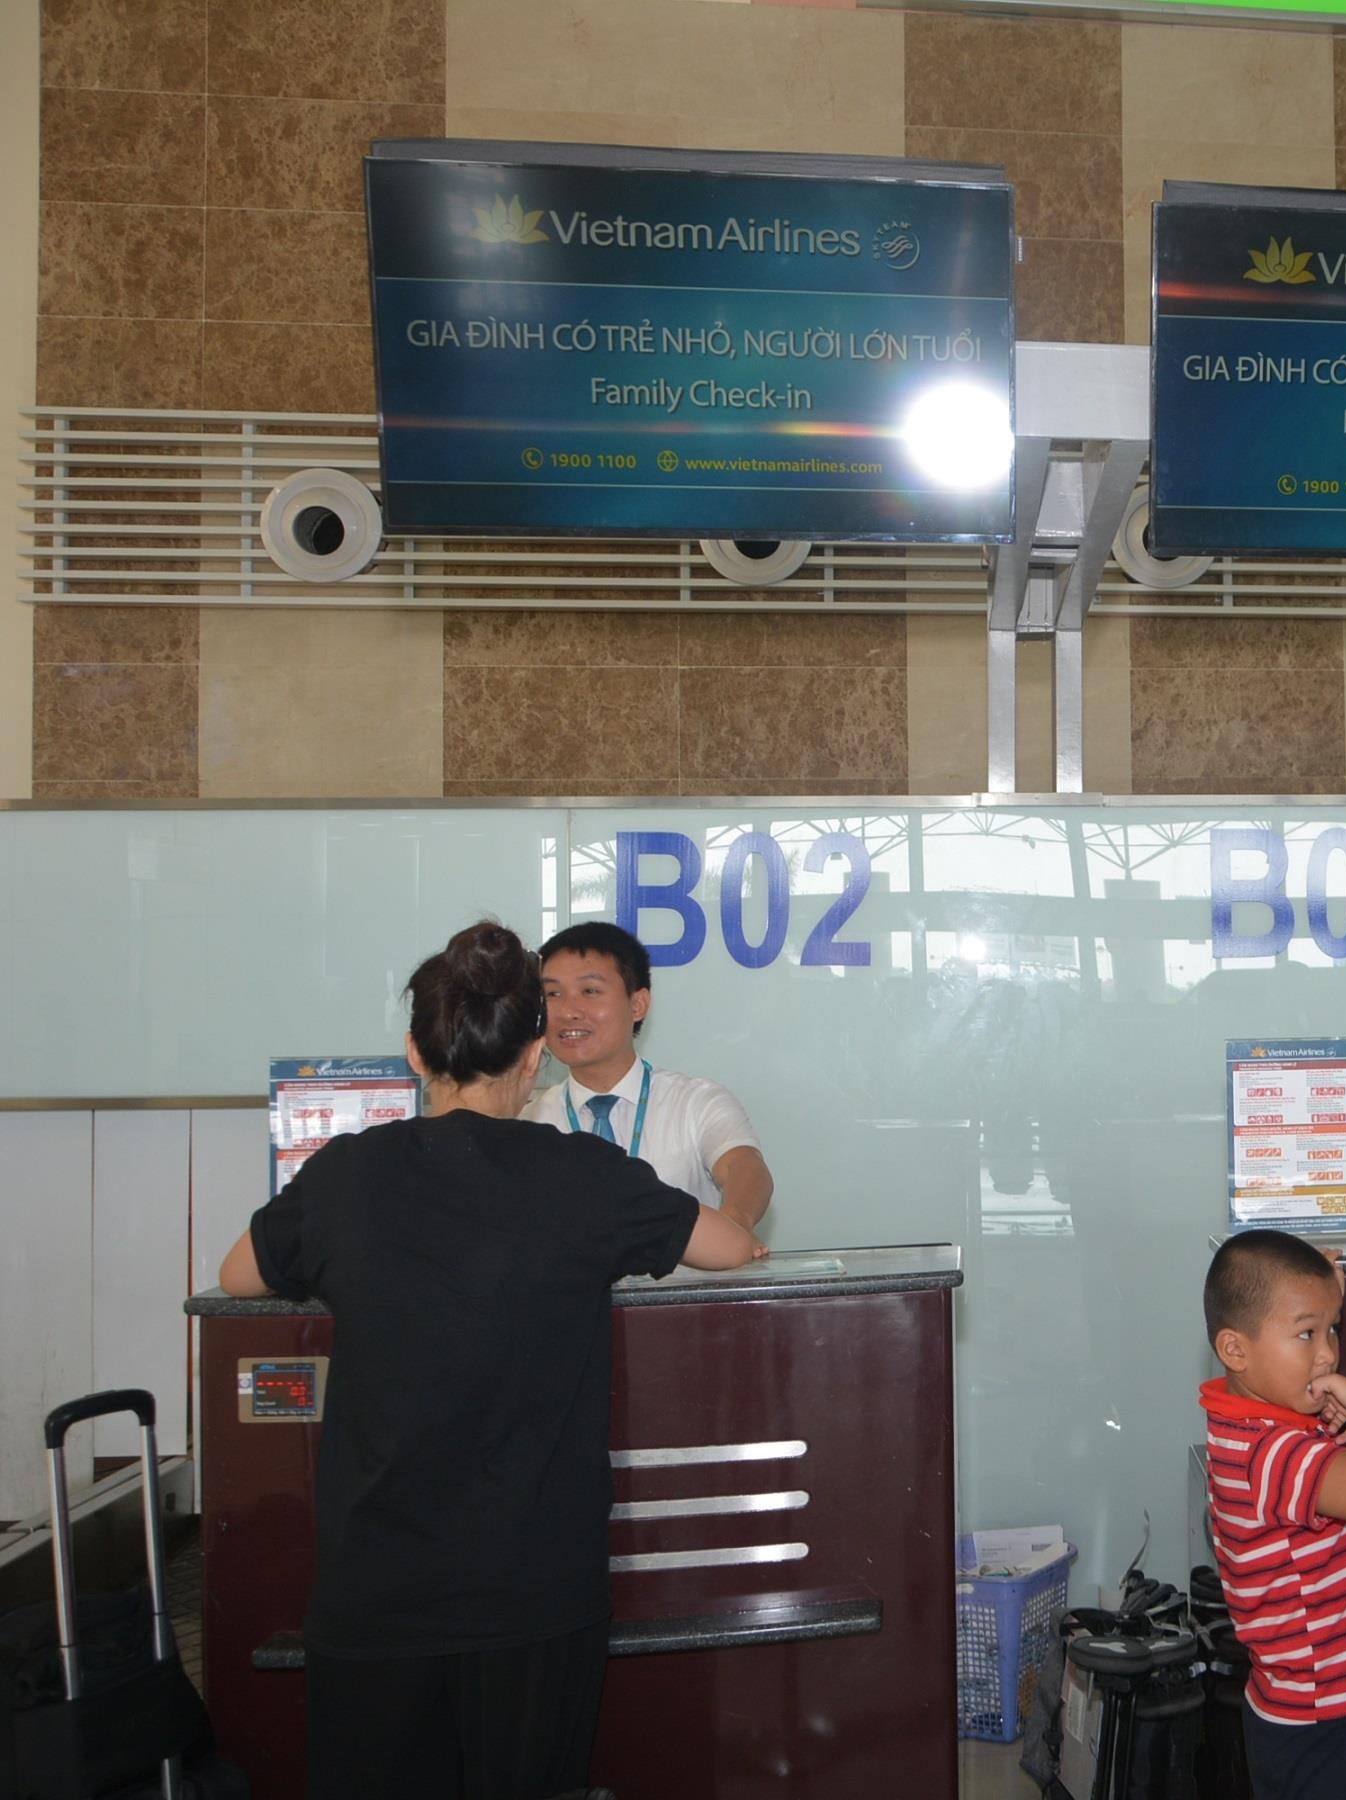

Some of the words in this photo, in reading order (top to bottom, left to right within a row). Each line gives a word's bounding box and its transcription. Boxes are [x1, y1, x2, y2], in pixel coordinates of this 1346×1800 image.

[549, 209, 713, 250] Vietnam
[717, 217, 861, 256] Airlines
[406, 318, 461, 348] GIA
[466, 315, 546, 350] ĐÌNH
[552, 318, 597, 352] CÓ
[600, 318, 656, 354] TRẺ
[662, 320, 737, 360] NHỎ,
[743, 326, 842, 360] NGƯỜI
[850, 328, 908, 361] LỚN
[912, 328, 982, 363] TUỔI
[1183, 353, 1231, 382] GIA
[1235, 351, 1305, 384] ĐÌNH
[590, 377, 683, 413] Family
[689, 379, 813, 410] Check-in
[550, 452, 592, 469] 1900
[597, 453, 637, 469] 1100
[685, 455, 883, 475] www.vietnamairlines.com
[1302, 479, 1340, 495] 1900
[614, 830, 873, 970] B02
[1266, 1047, 1298, 1057] Vietnam
[1298, 1047, 1325, 1057] Airlines
[351, 1066, 383, 1077] Airlines
